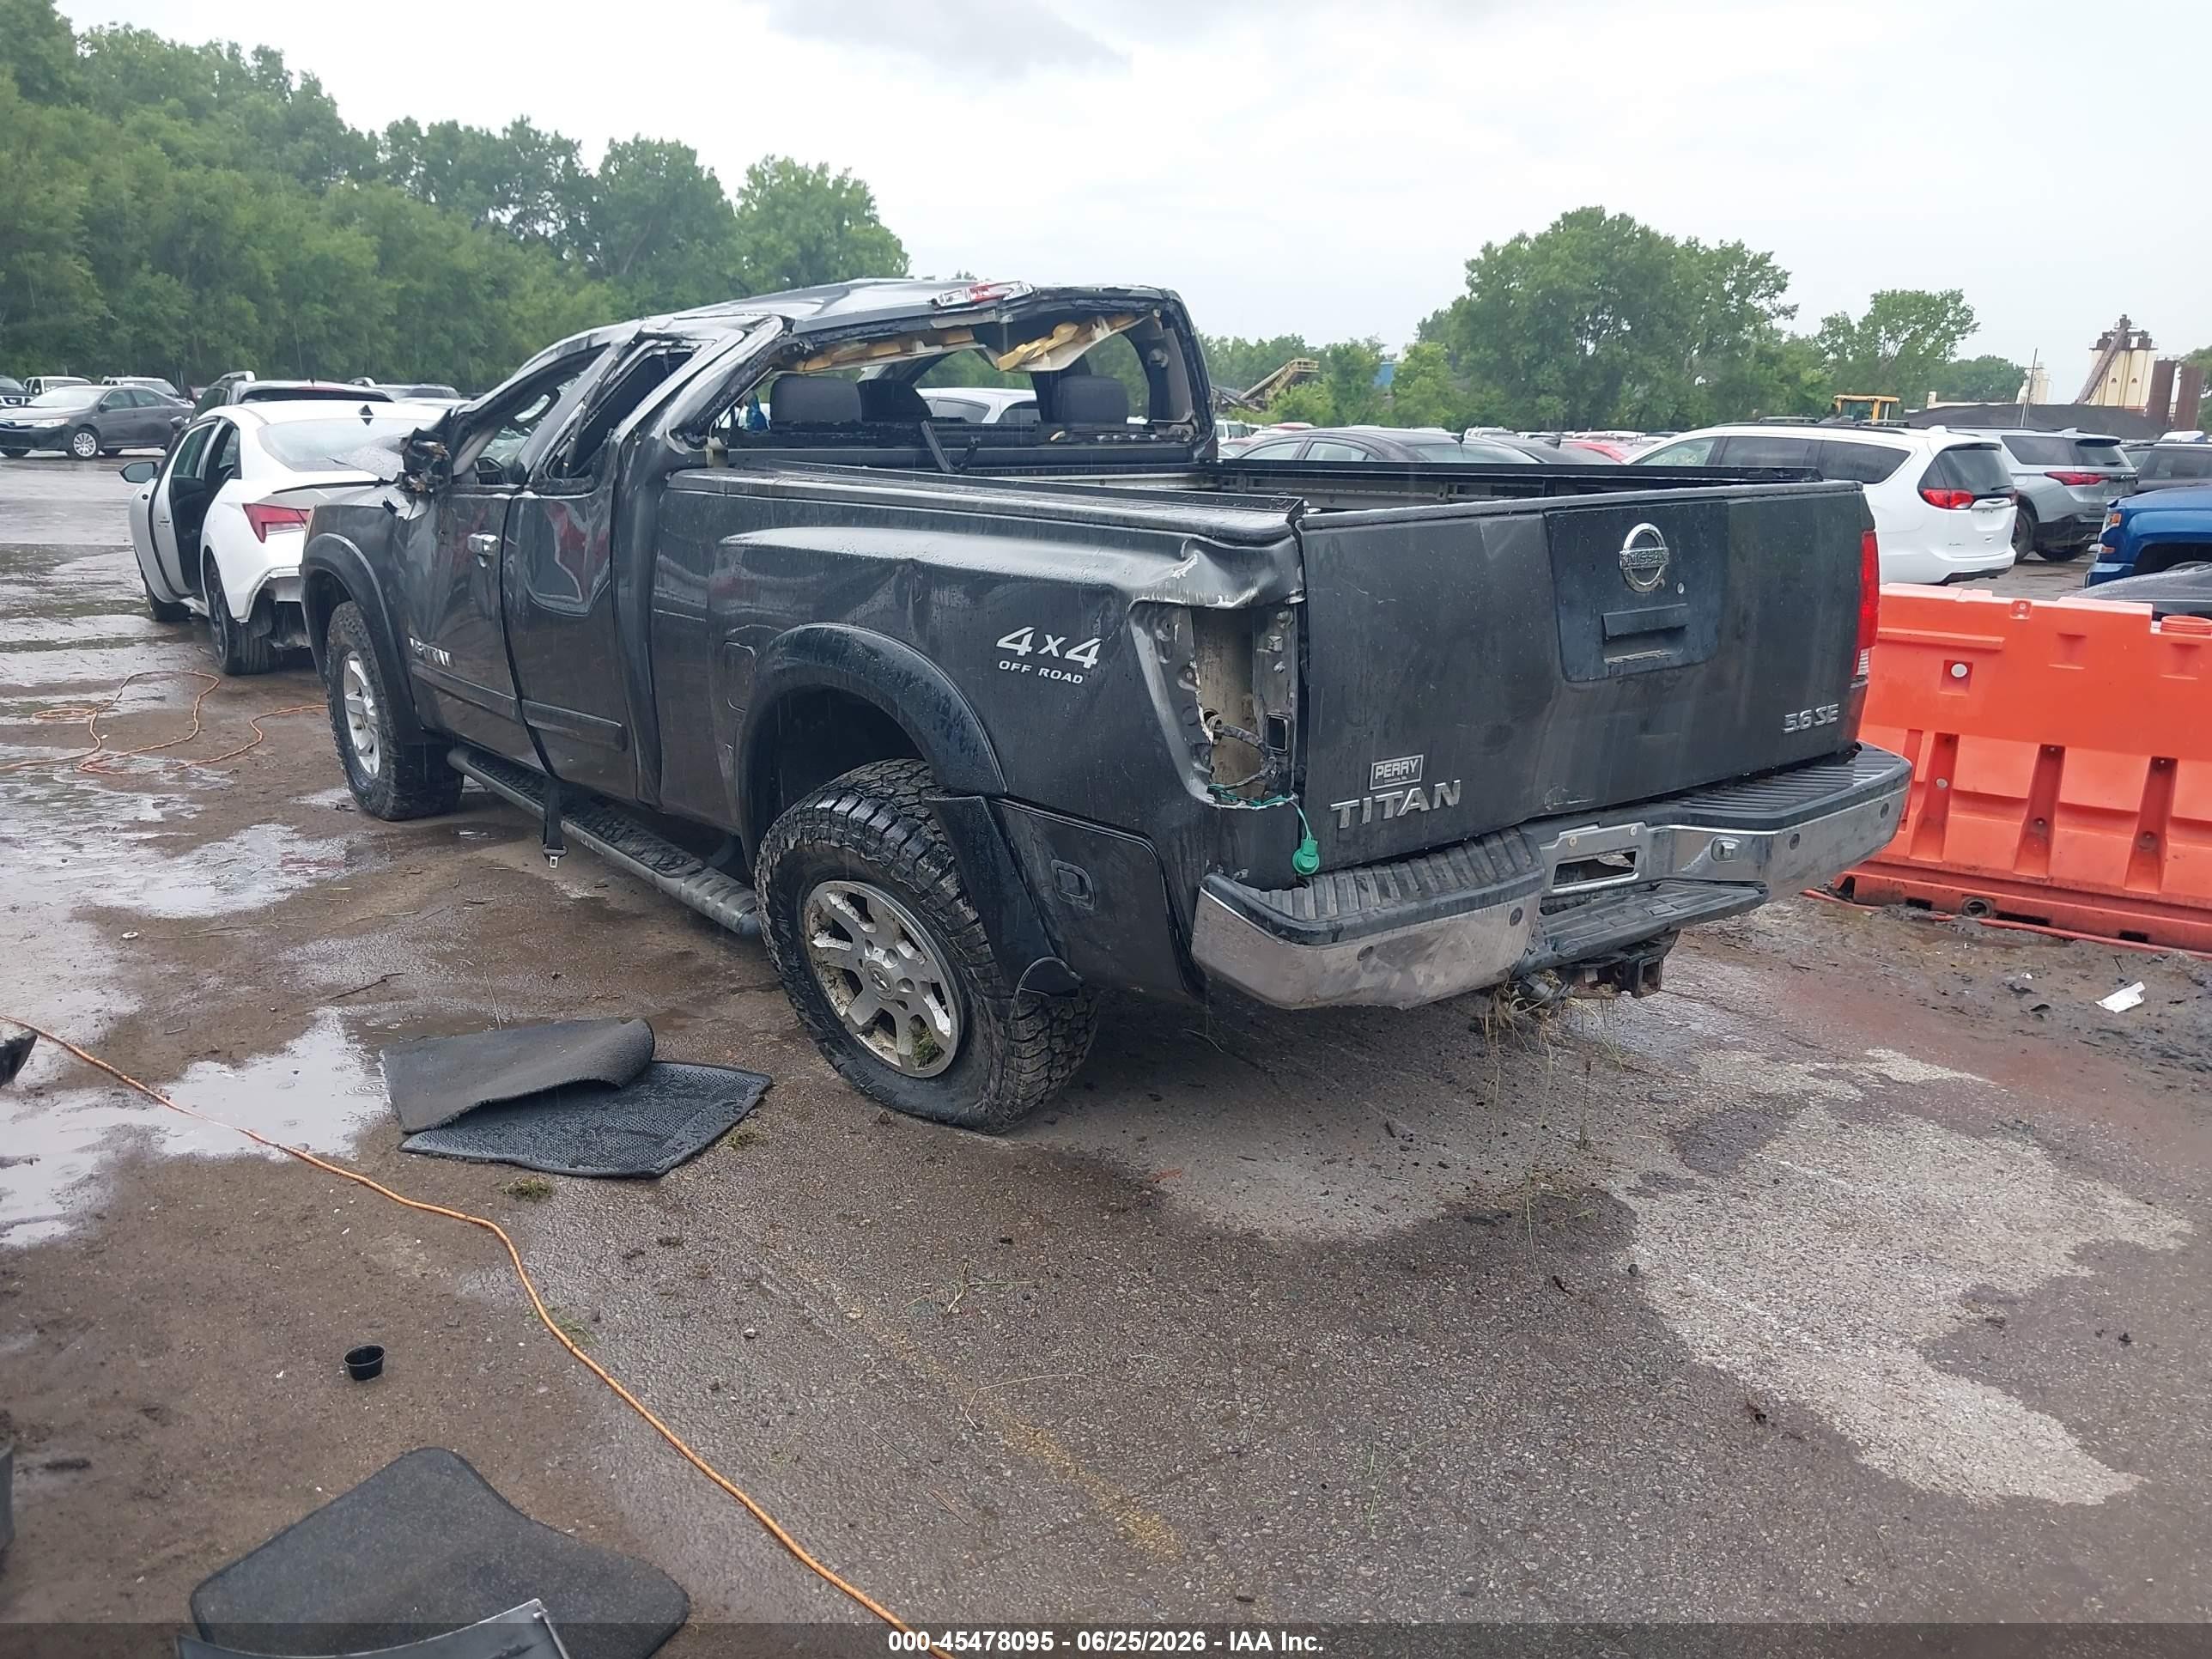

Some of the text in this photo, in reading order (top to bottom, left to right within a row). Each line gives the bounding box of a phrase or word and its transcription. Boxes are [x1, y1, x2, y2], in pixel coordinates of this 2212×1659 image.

[999, 660, 1084, 684] OFF ROAD
[1375, 759, 1419, 780] PERRY
[1331, 780, 1461, 829] TITAN
